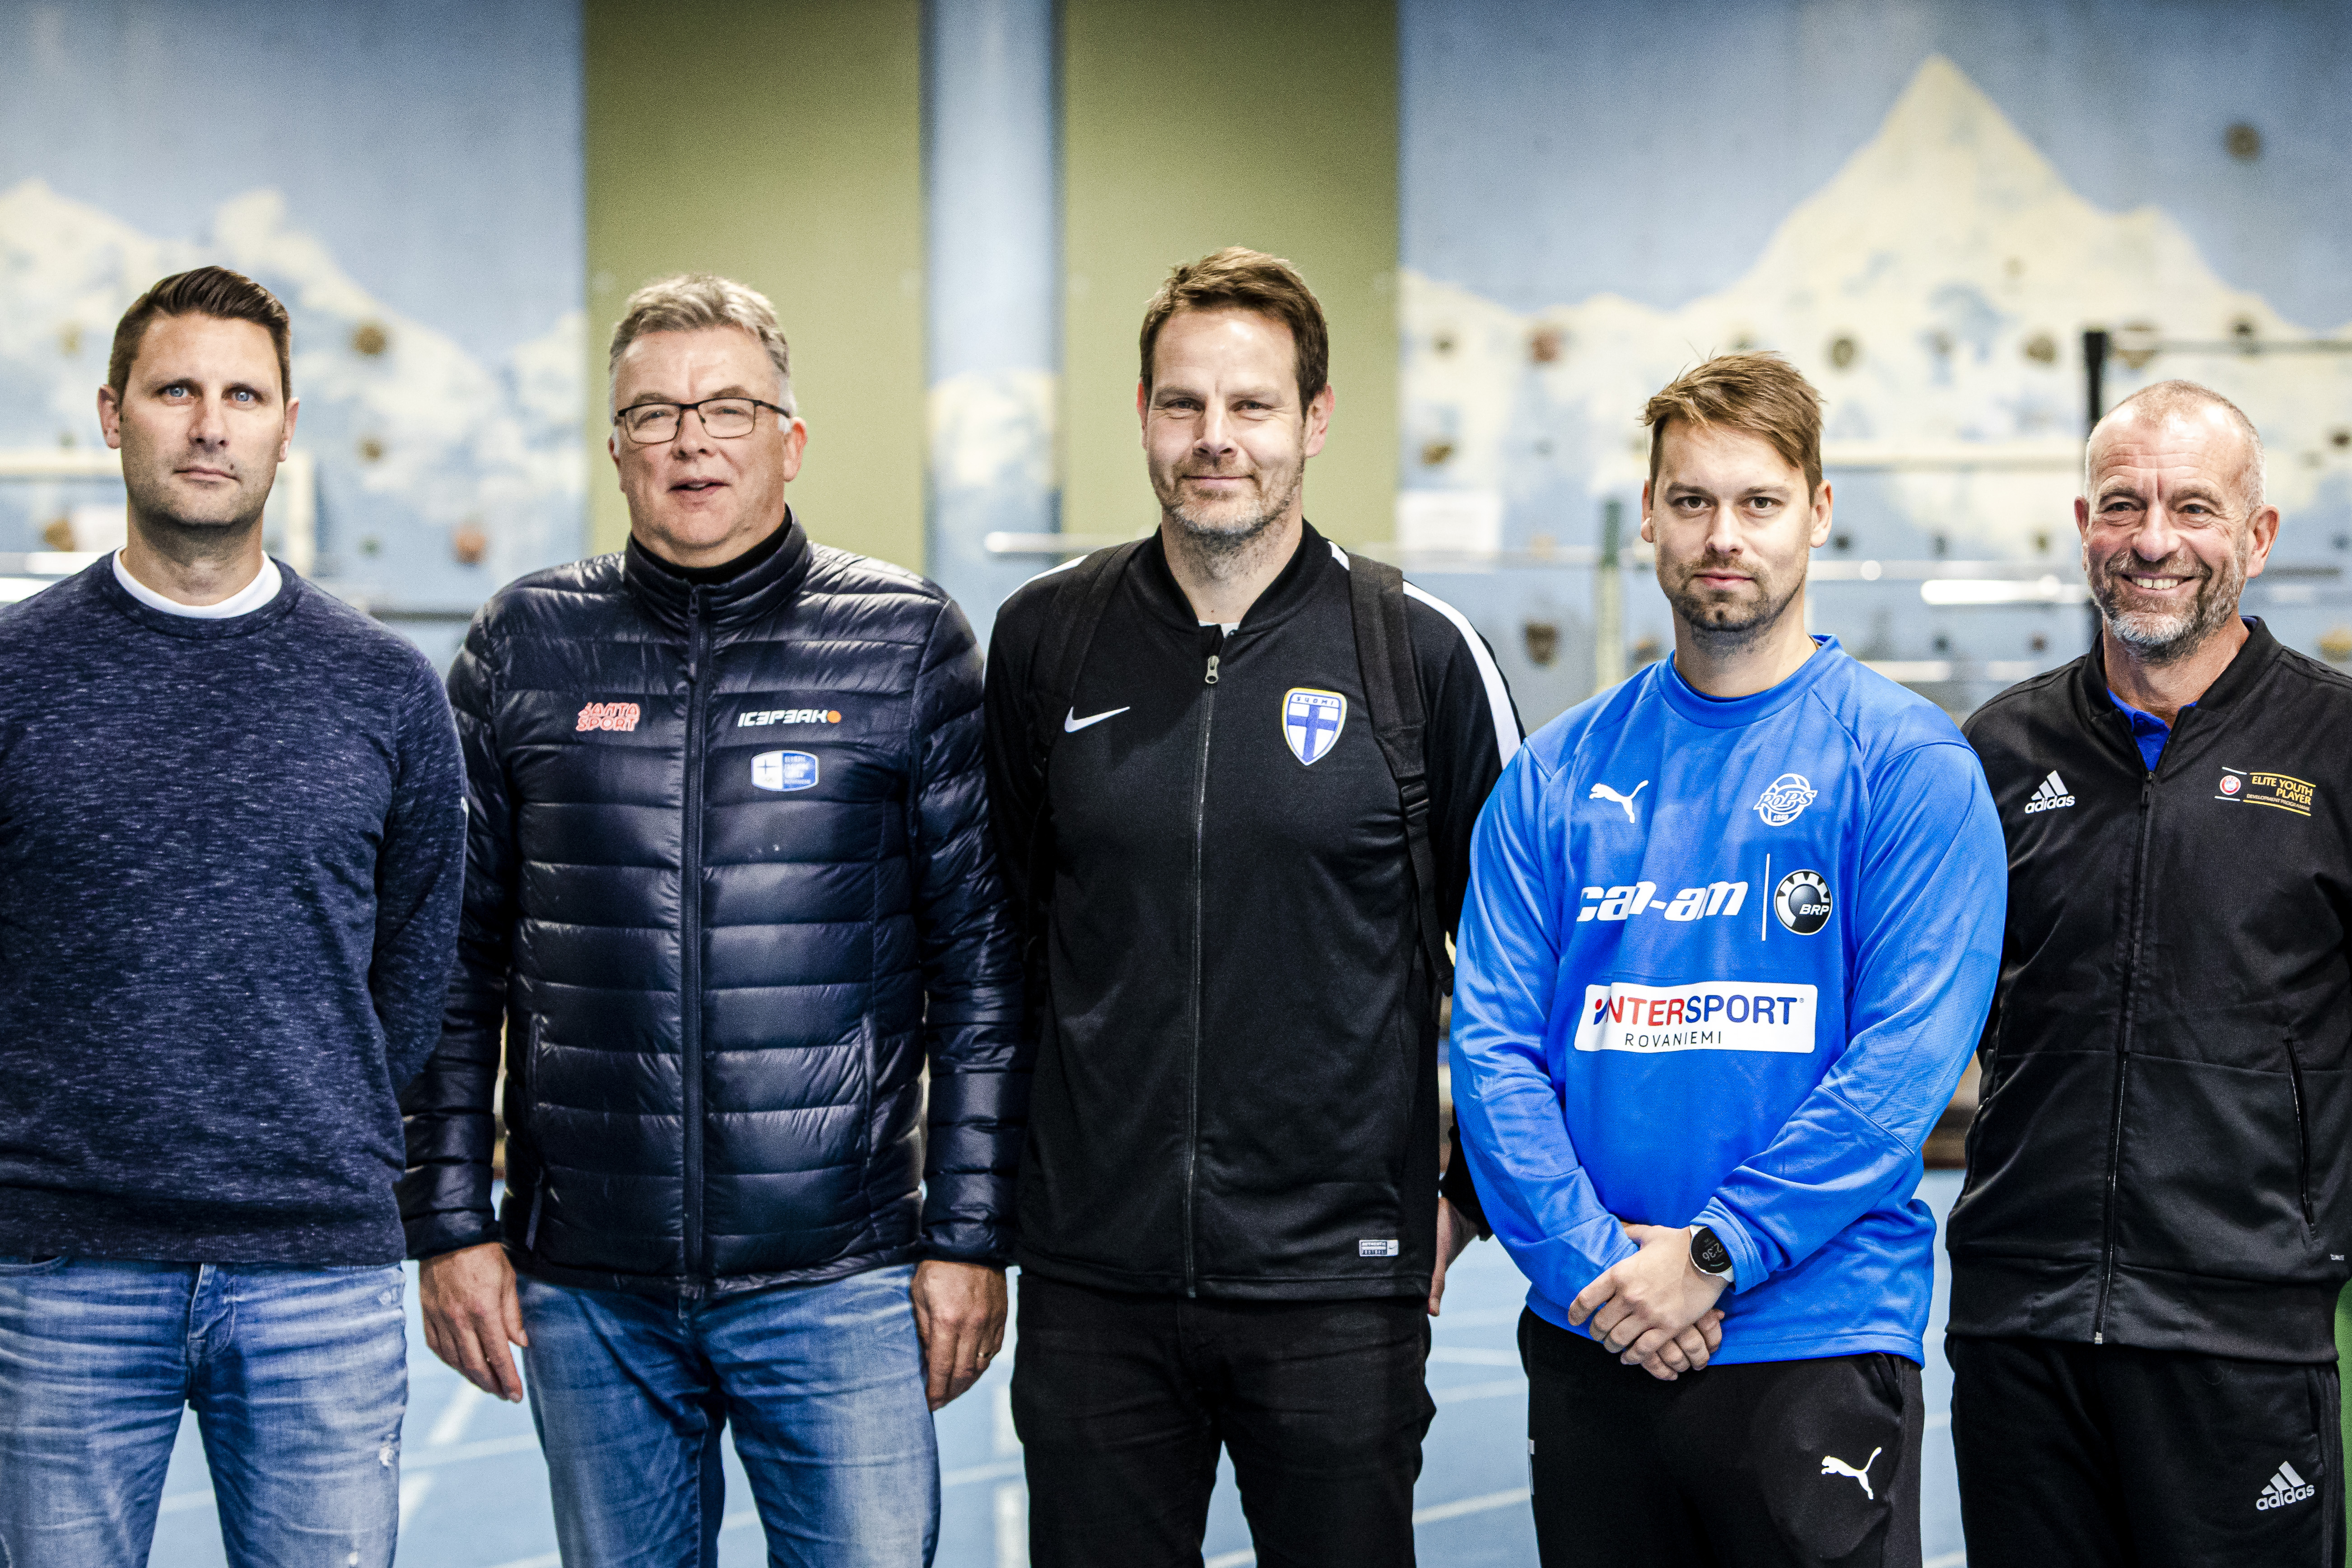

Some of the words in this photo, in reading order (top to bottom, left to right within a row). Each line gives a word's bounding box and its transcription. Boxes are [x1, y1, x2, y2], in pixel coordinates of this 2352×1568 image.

[1297, 696, 1333, 705] SUOMI
[578, 702, 640, 717] SANTA
[737, 709, 828, 727] ICEPEAK
[576, 716, 639, 731] SPORT
[2252, 776, 2277, 786] ELITE
[2279, 779, 2313, 796] YOUTH
[2024, 795, 2075, 814] adidas
[2276, 787, 2311, 805] PLAYER
[1799, 904, 1830, 915] BRP
[1625, 1031, 1721, 1047] ROVANIEMI
[2256, 1484, 2315, 1511] adidas
